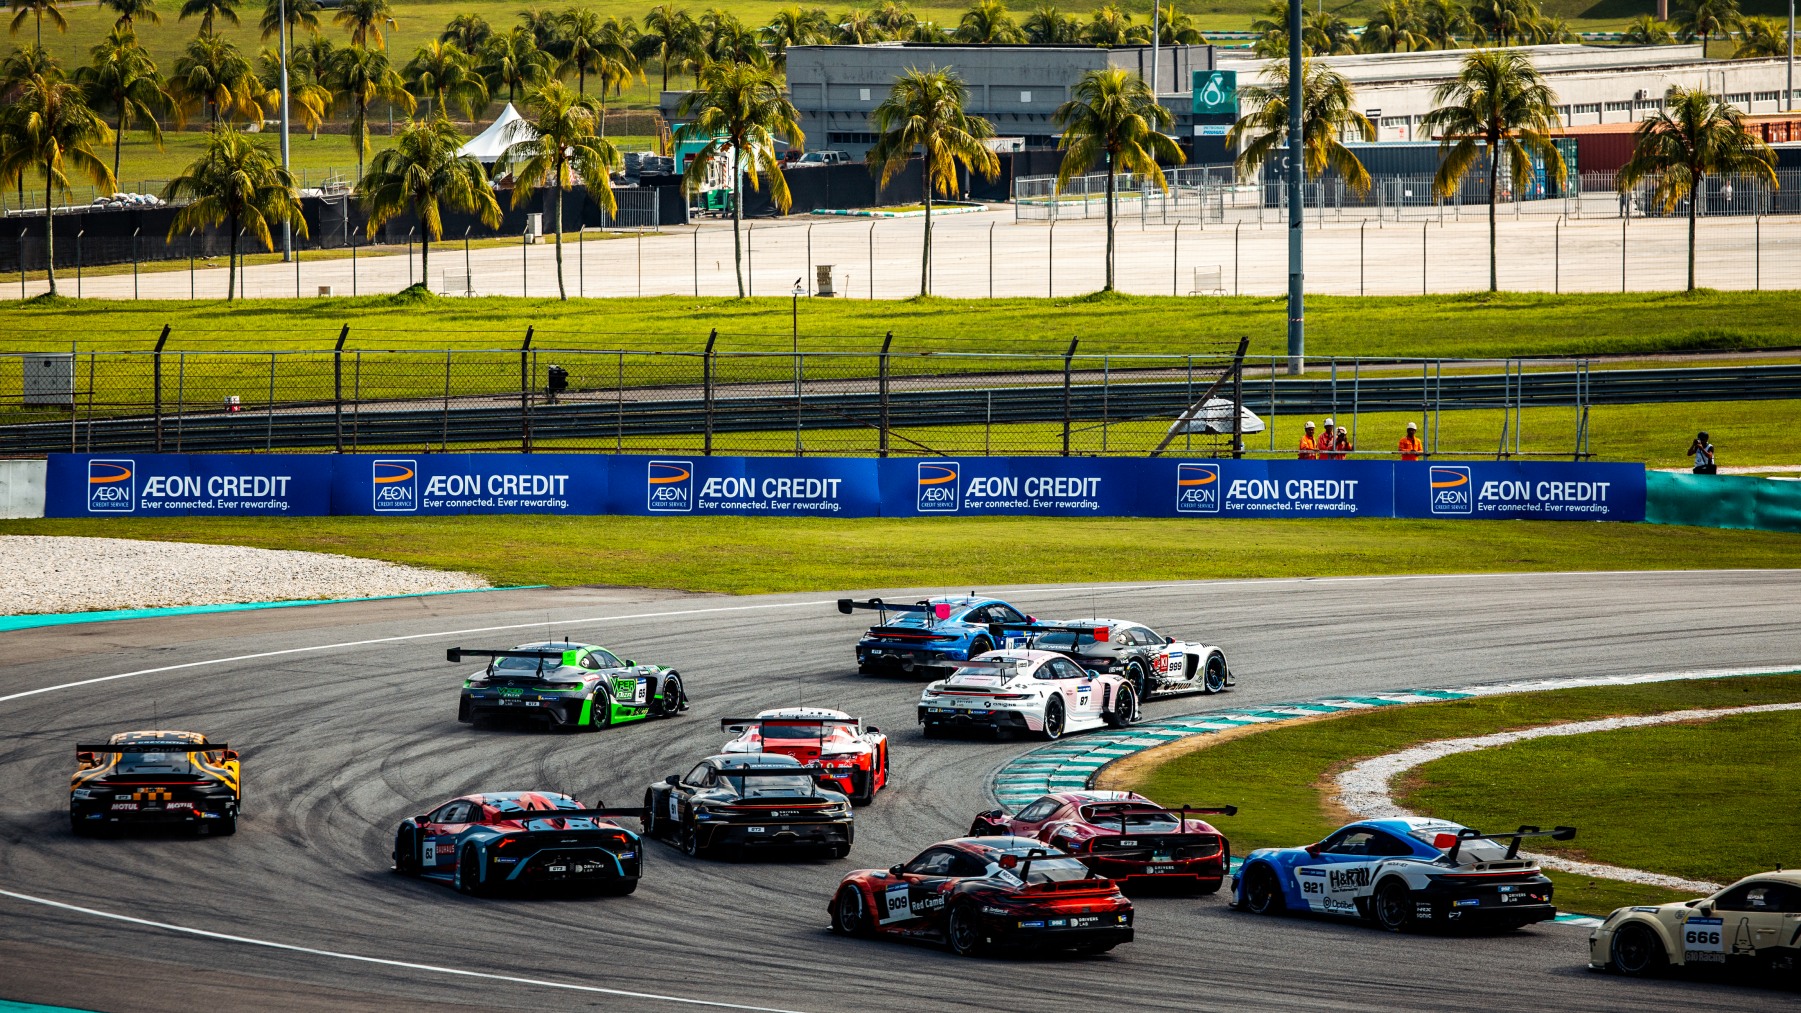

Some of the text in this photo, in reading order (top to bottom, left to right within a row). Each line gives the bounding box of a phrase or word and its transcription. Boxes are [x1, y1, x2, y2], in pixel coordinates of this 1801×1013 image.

[142, 476, 291, 497] ÆON CREDIT
[424, 475, 569, 496] ÆON CREDIT
[700, 477, 842, 498] ÆON CREDIT
[966, 477, 1101, 497] ÆON CREDIT
[1226, 480, 1358, 500] ÆON CREDIT
[1478, 481, 1610, 501] ÆON CREDIT
[142, 500, 290, 510] Ever connected. Ever rewarding.
[424, 498, 569, 508] Ever connected. Ever rewarding.
[699, 500, 841, 511] Ever connected. Ever rewarding.
[965, 500, 1100, 510] Ever connected. Ever rewarding.
[1226, 501, 1358, 512] Ever connected. Ever rewarding.
[1478, 503, 1610, 513] Ever connected. Ever rewarding.
[1169, 662, 1182, 671] 999
[638, 688, 645, 698] 65
[426, 848, 432, 859] 63
[436, 845, 455, 853] BAUHAUS
[1303, 881, 1323, 894] 921
[889, 896, 907, 910] 909
[912, 900, 924, 910] Red
[925, 895, 944, 908] Camel
[1686, 931, 1720, 944] 666
[1685, 951, 1725, 963] 610 Racing
